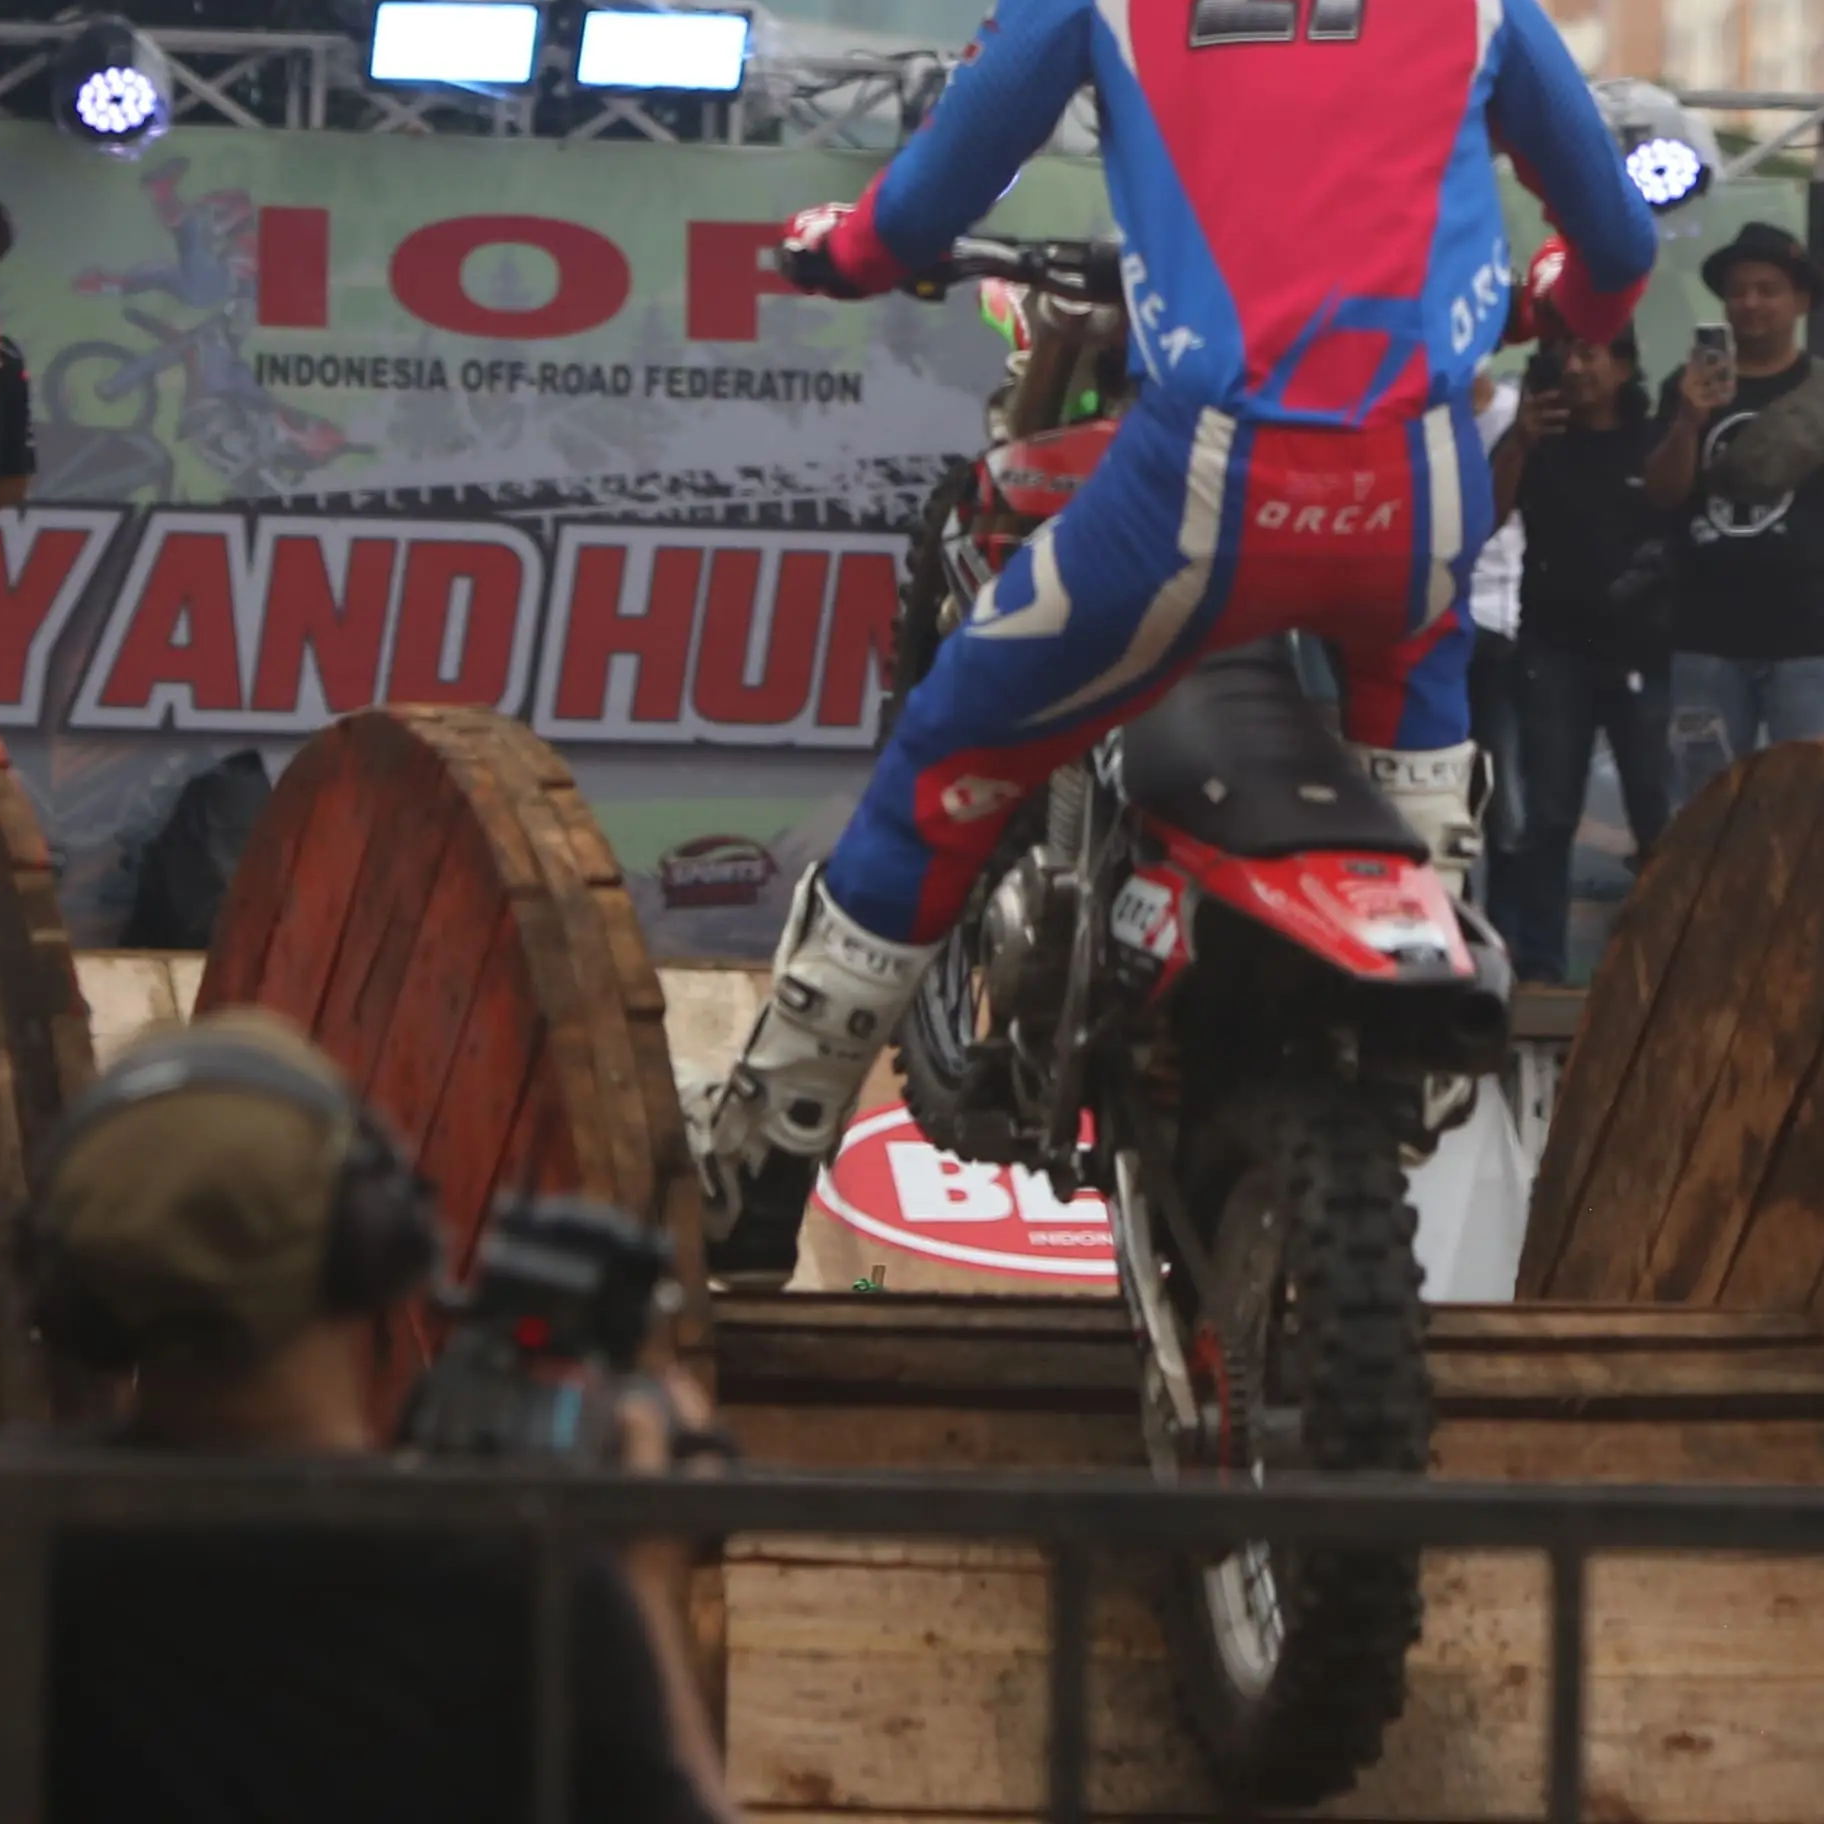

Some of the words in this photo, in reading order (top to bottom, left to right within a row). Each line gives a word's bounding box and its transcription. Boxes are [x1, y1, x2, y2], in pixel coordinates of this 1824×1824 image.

[255, 352, 451, 393] INDONESIA
[460, 358, 633, 398] OFF-ROAD
[643, 364, 863, 405] FEDERATION
[1255, 497, 1403, 536] ORCA
